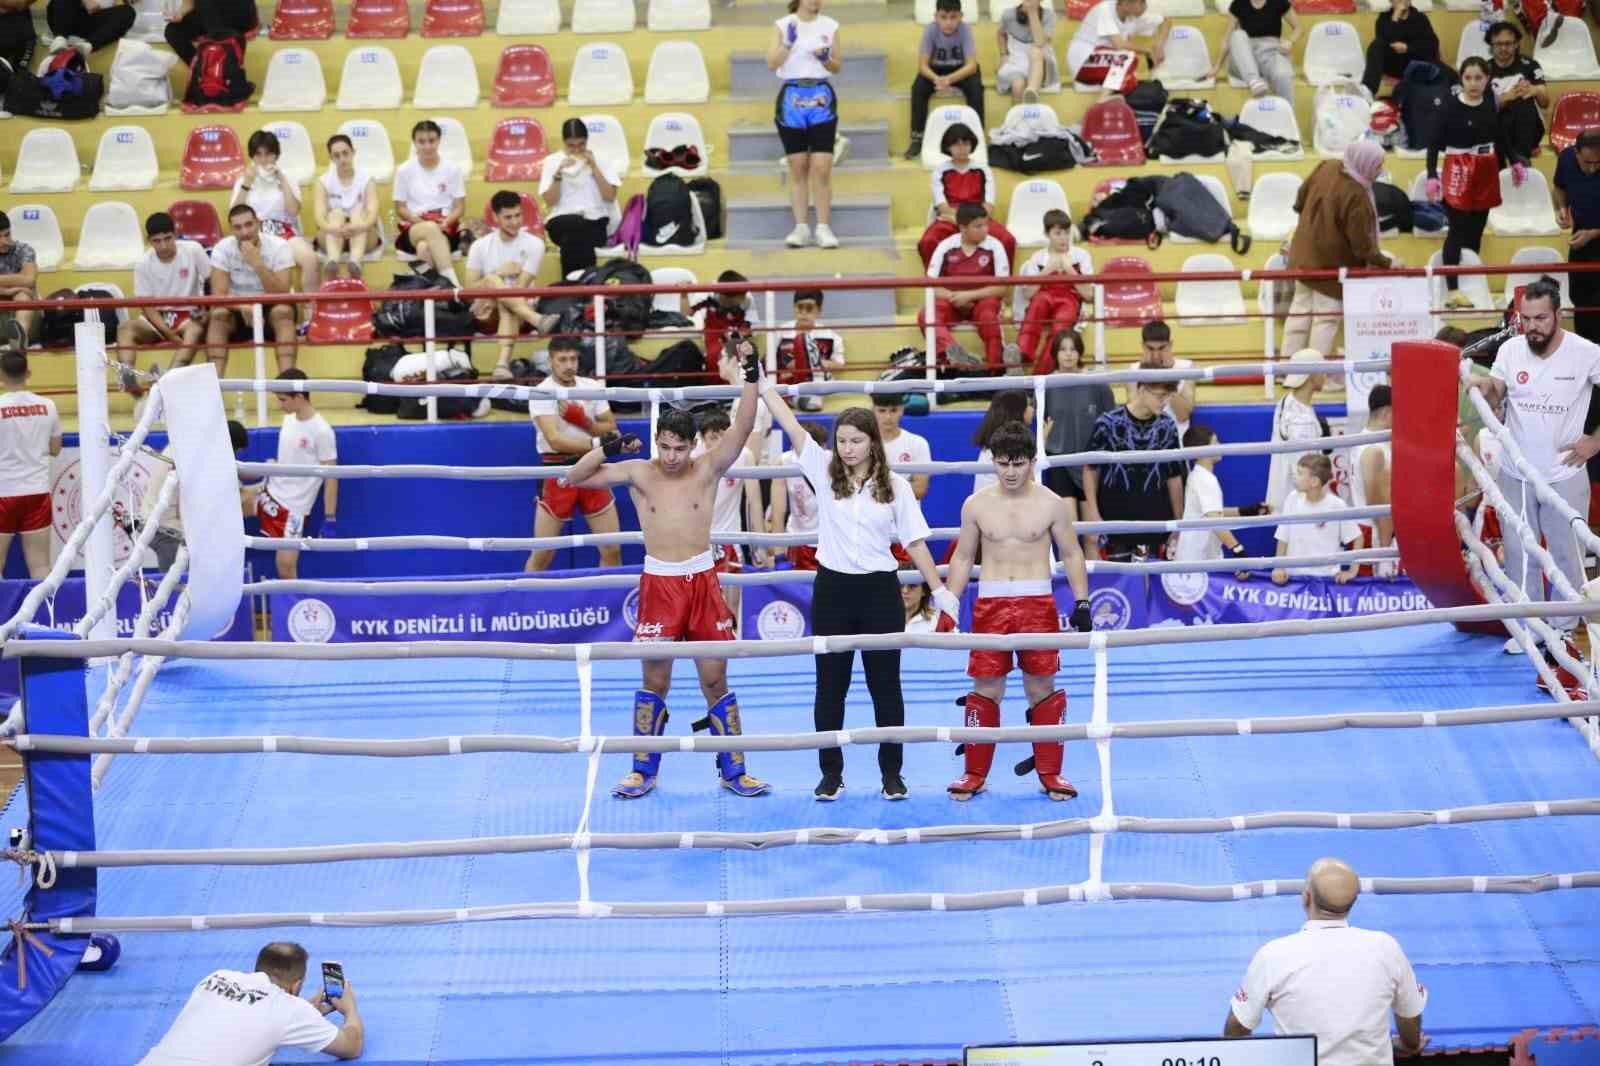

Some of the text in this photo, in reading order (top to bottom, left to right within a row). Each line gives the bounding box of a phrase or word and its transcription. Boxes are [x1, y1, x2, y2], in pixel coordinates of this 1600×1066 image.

[1223, 585, 1259, 604] KYK
[1265, 590, 1332, 612] DENİZLİ
[1337, 593, 1352, 613] İL
[352, 619, 388, 635] KYK
[394, 613, 464, 634] DENİZLİ
[470, 613, 487, 633] İL
[491, 606, 610, 631] MÜDÜRLÜĞÜ
